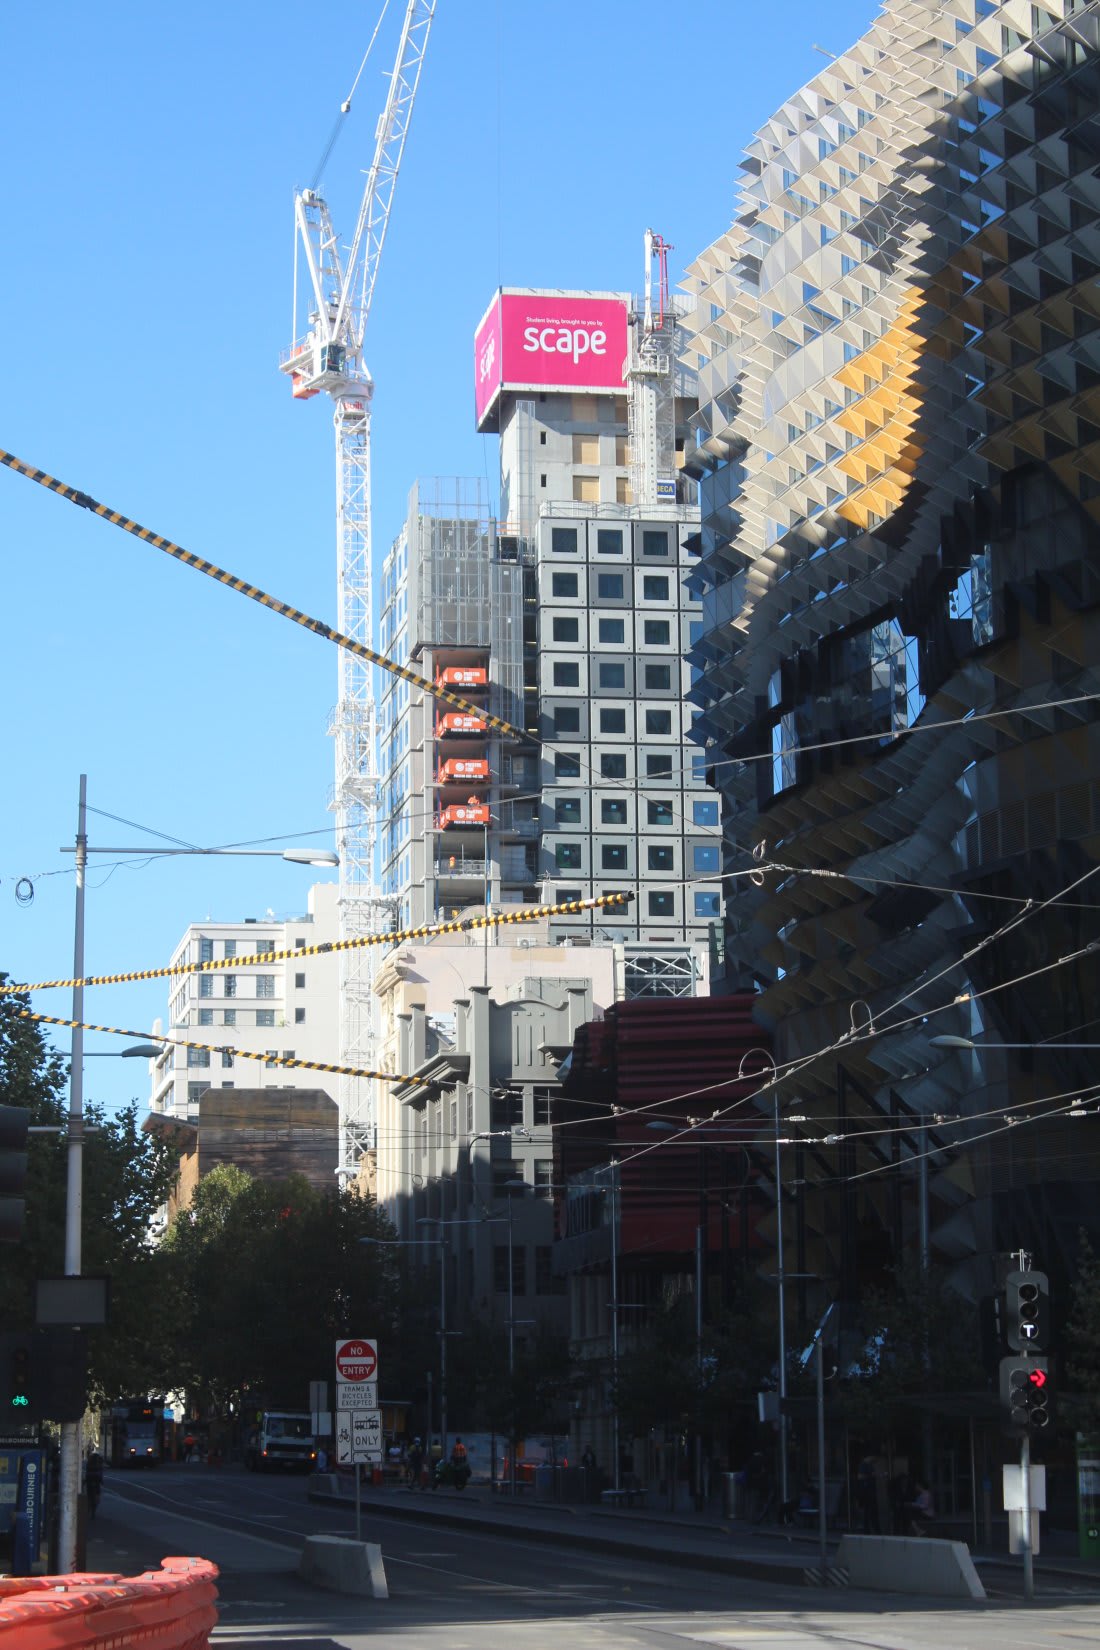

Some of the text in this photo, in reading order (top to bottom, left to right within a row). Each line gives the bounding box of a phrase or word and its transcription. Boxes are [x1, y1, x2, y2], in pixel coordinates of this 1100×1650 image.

[546, 317, 561, 325] living,
[561, 318, 580, 326] brought
[597, 319, 603, 327] by
[523, 326, 607, 365] scape
[350, 1346, 363, 1356] NO
[342, 1366, 371, 1375] ENTRY
[355, 1435, 379, 1446] ONLY
